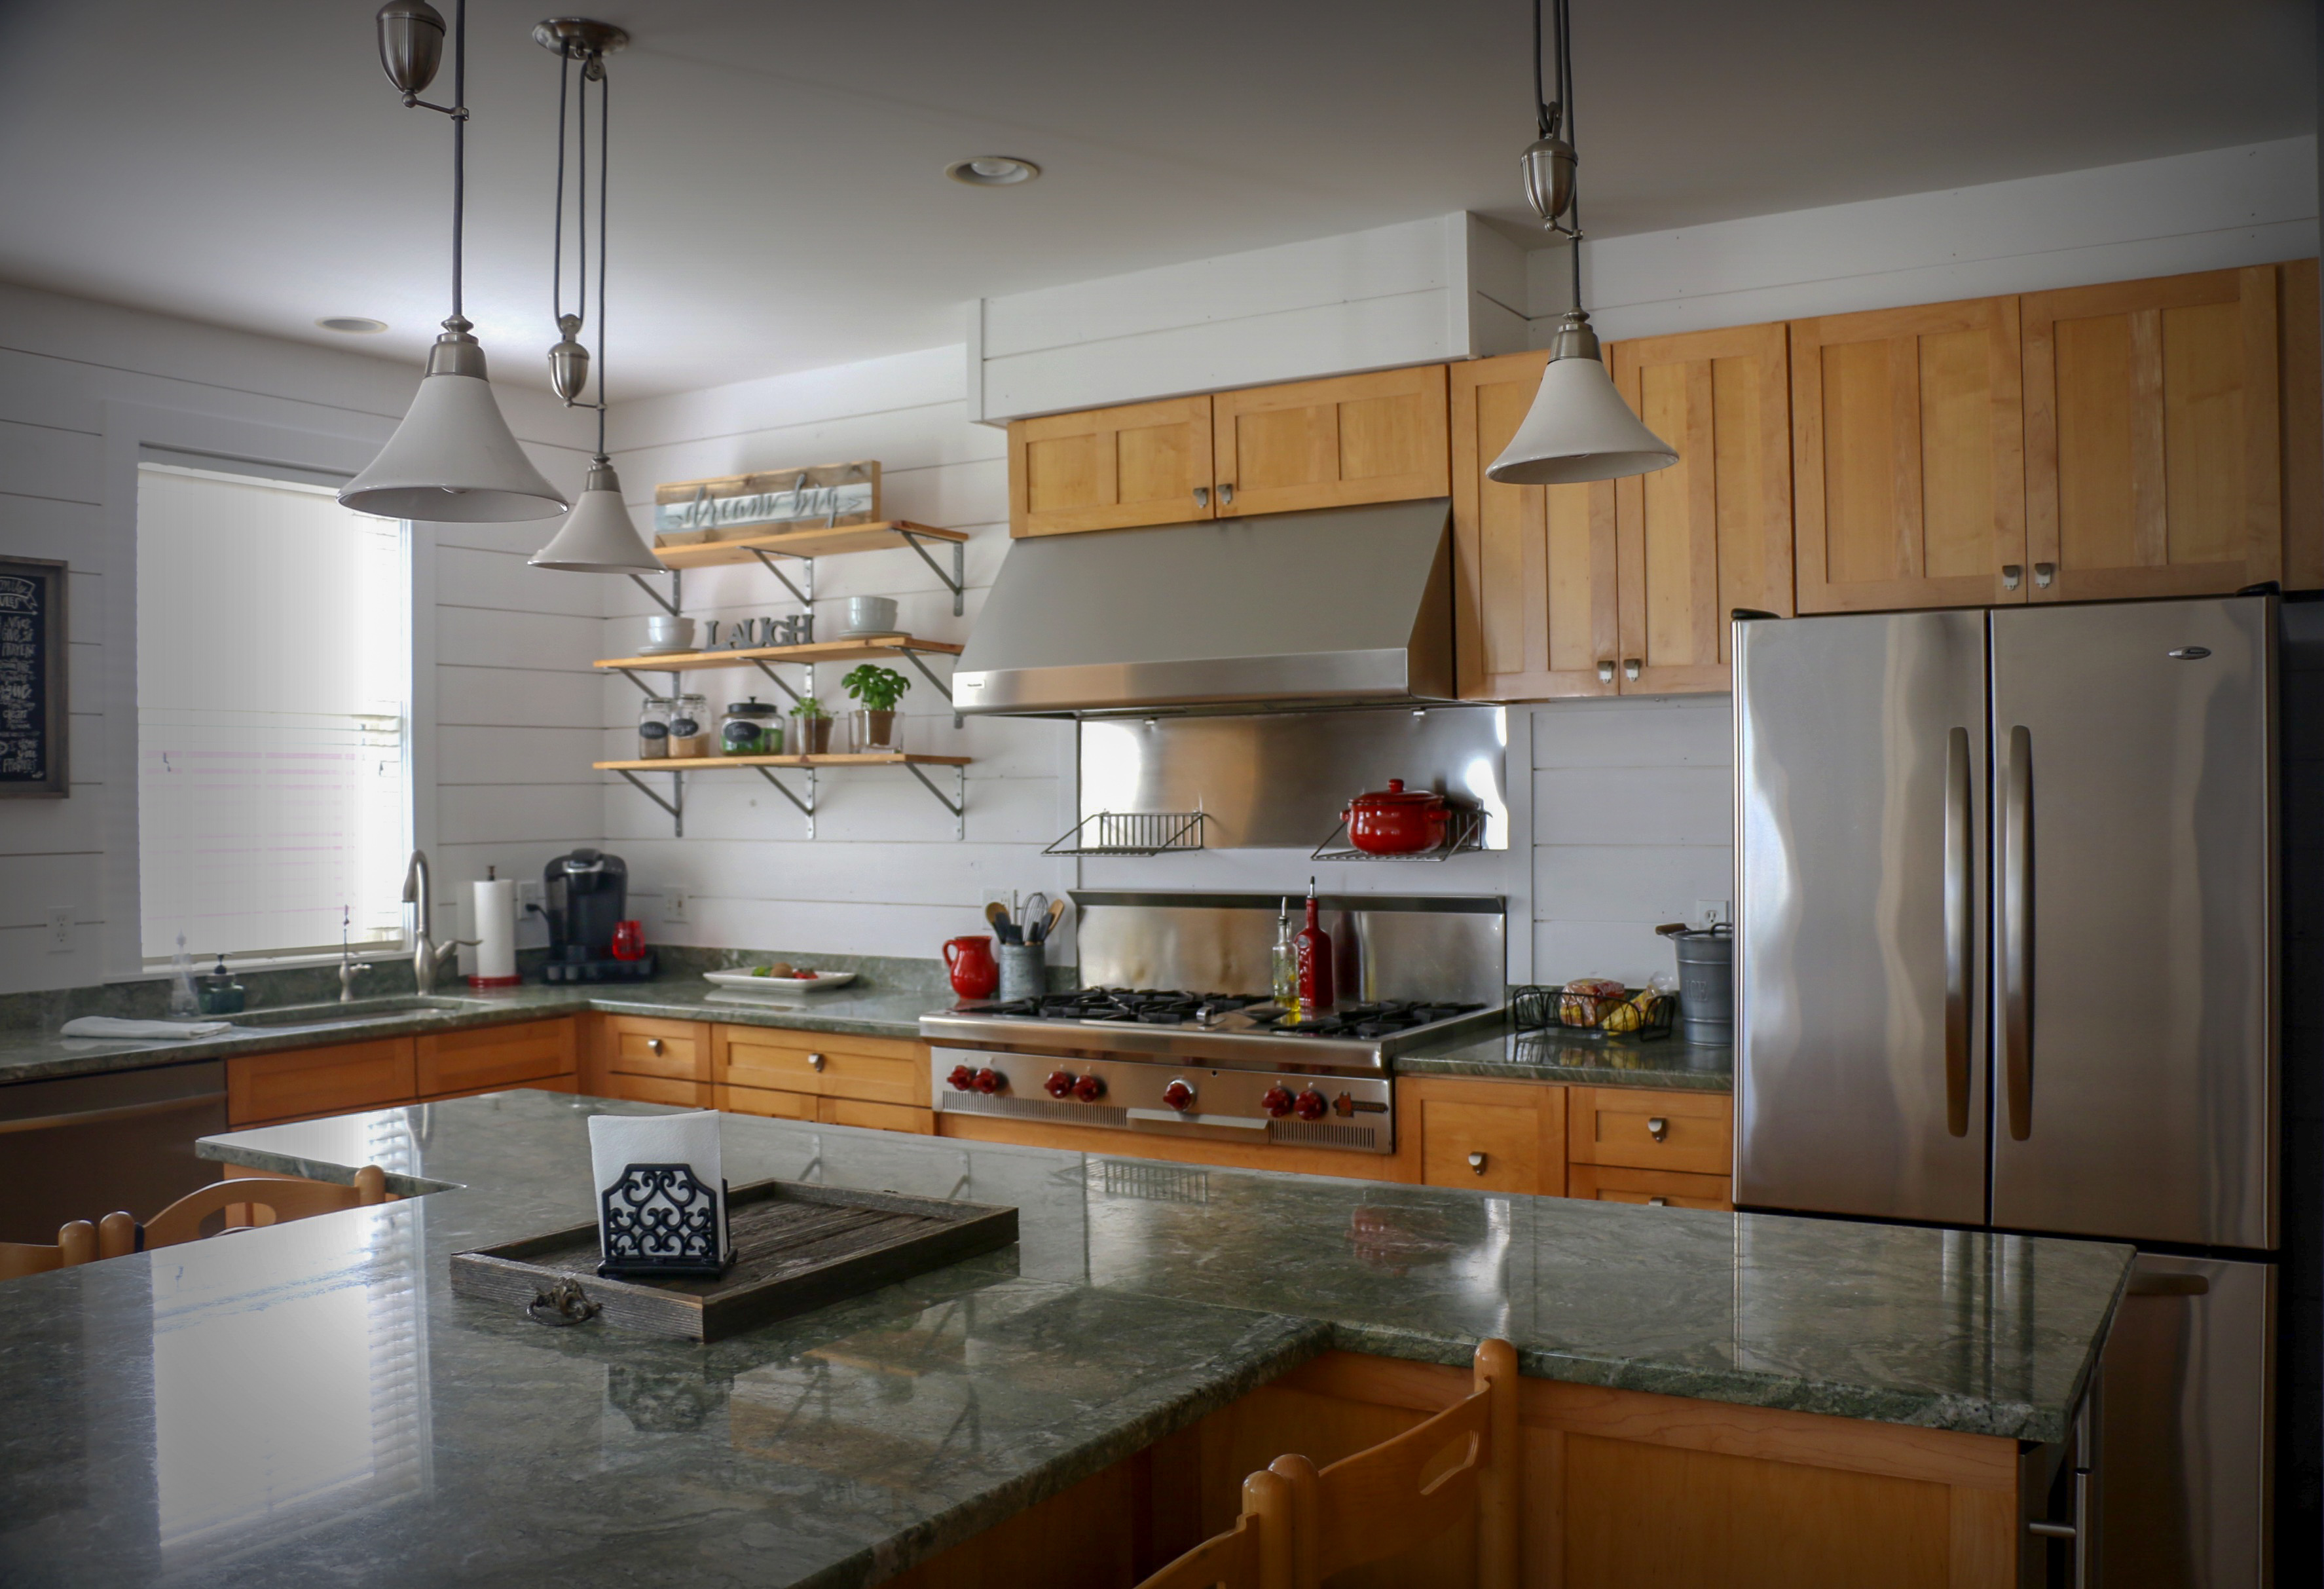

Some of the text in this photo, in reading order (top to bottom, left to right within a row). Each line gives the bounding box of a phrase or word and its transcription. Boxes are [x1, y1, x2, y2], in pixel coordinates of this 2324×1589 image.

[685, 474, 839, 529] dream big
[705, 613, 816, 652] LAUGH
[1686, 980, 1708, 1001] ICE
